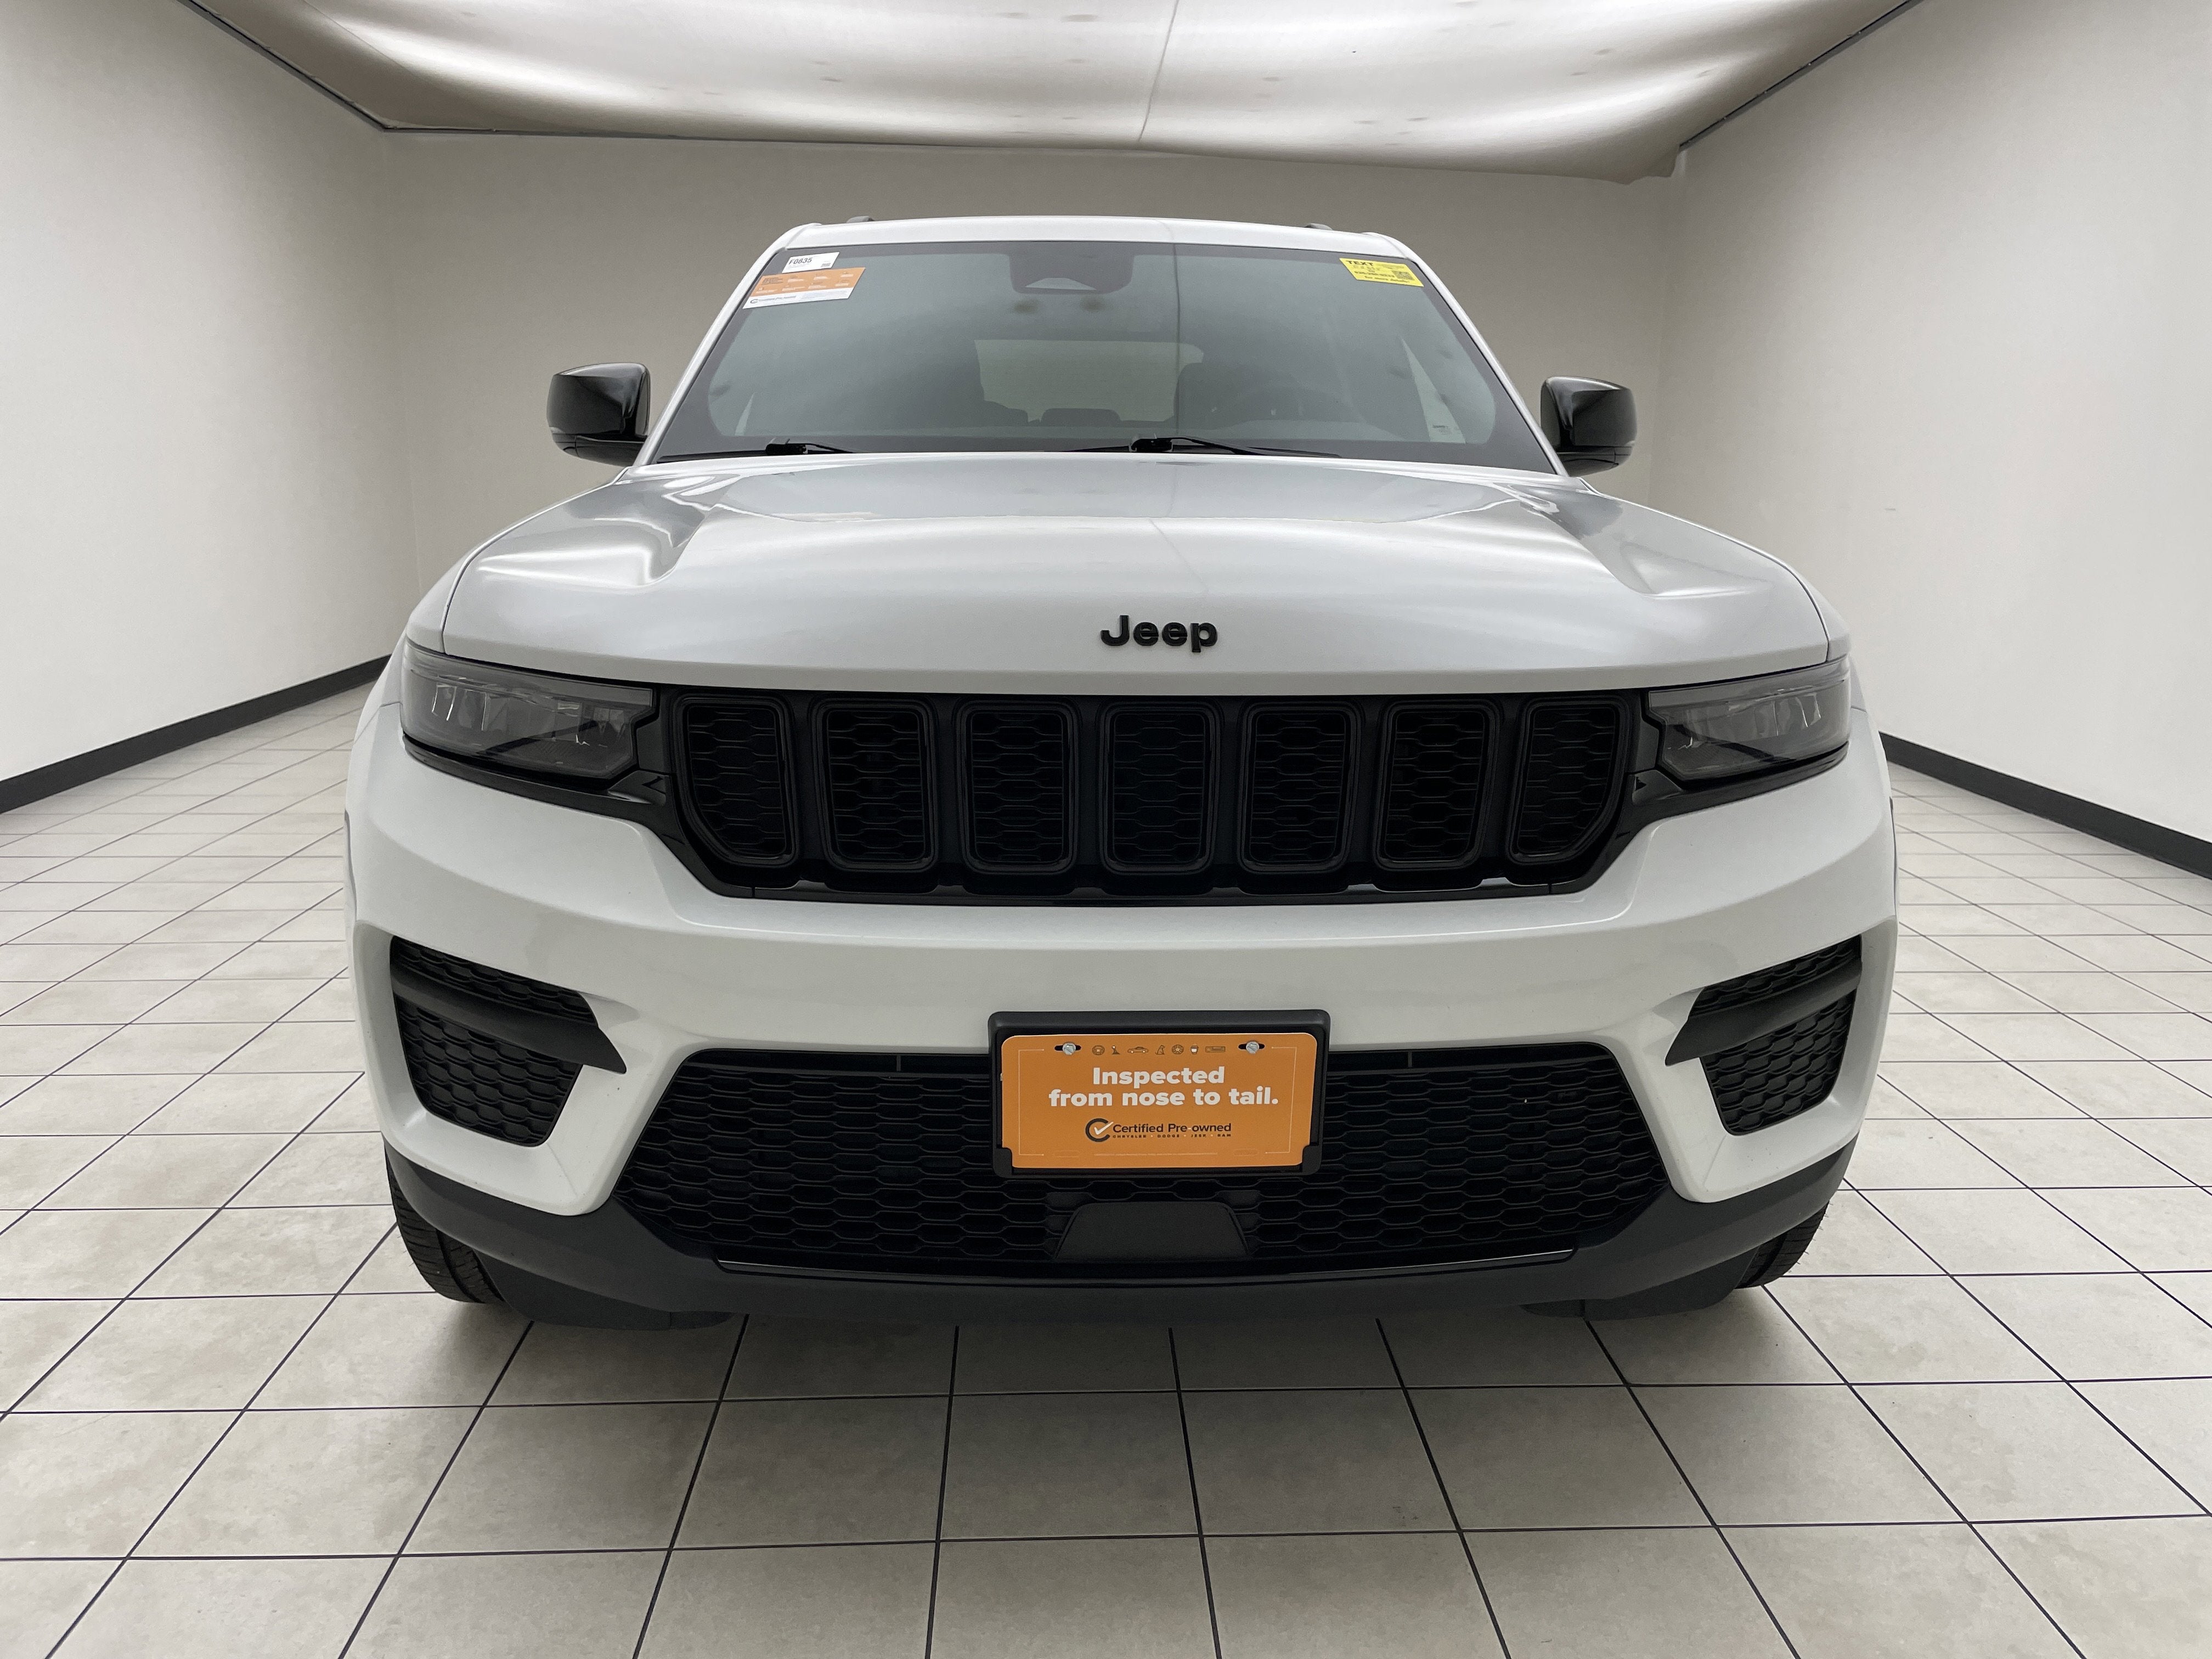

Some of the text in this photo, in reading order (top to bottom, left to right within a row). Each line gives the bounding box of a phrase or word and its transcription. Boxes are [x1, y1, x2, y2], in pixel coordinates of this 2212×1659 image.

[1101, 614, 1217, 652] Jeep
[1093, 1066, 1225, 1088] Inspected
[1048, 1086, 1278, 1107] from nose to tail.
[1113, 1123, 1231, 1132] Certified Pre-owned
